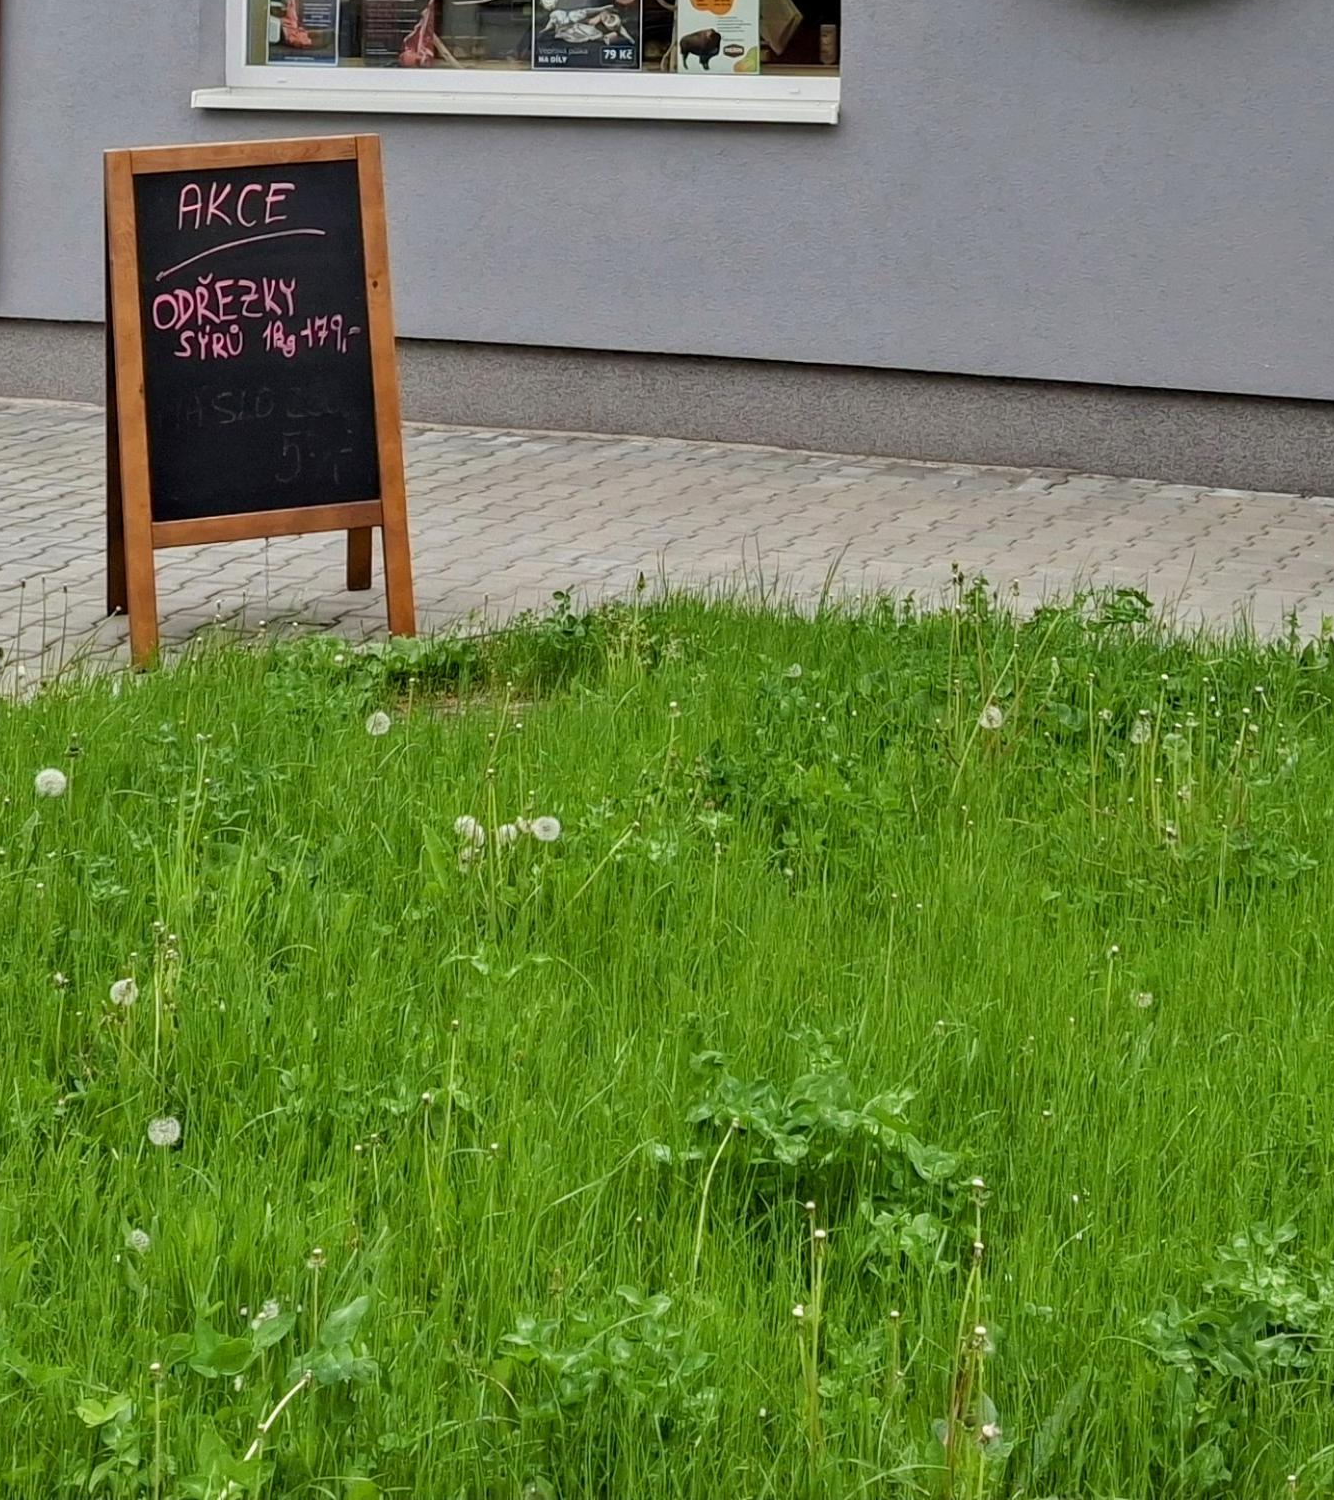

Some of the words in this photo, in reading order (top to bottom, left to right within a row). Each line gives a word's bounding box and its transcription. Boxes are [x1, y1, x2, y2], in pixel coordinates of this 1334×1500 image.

[603, 49, 617, 59] 79
[619, 49, 633, 60] Kč
[178, 180, 297, 231] AKCE
[152, 272, 297, 331] ODŘEZKY
[174, 324, 243, 361] SÝRŮ
